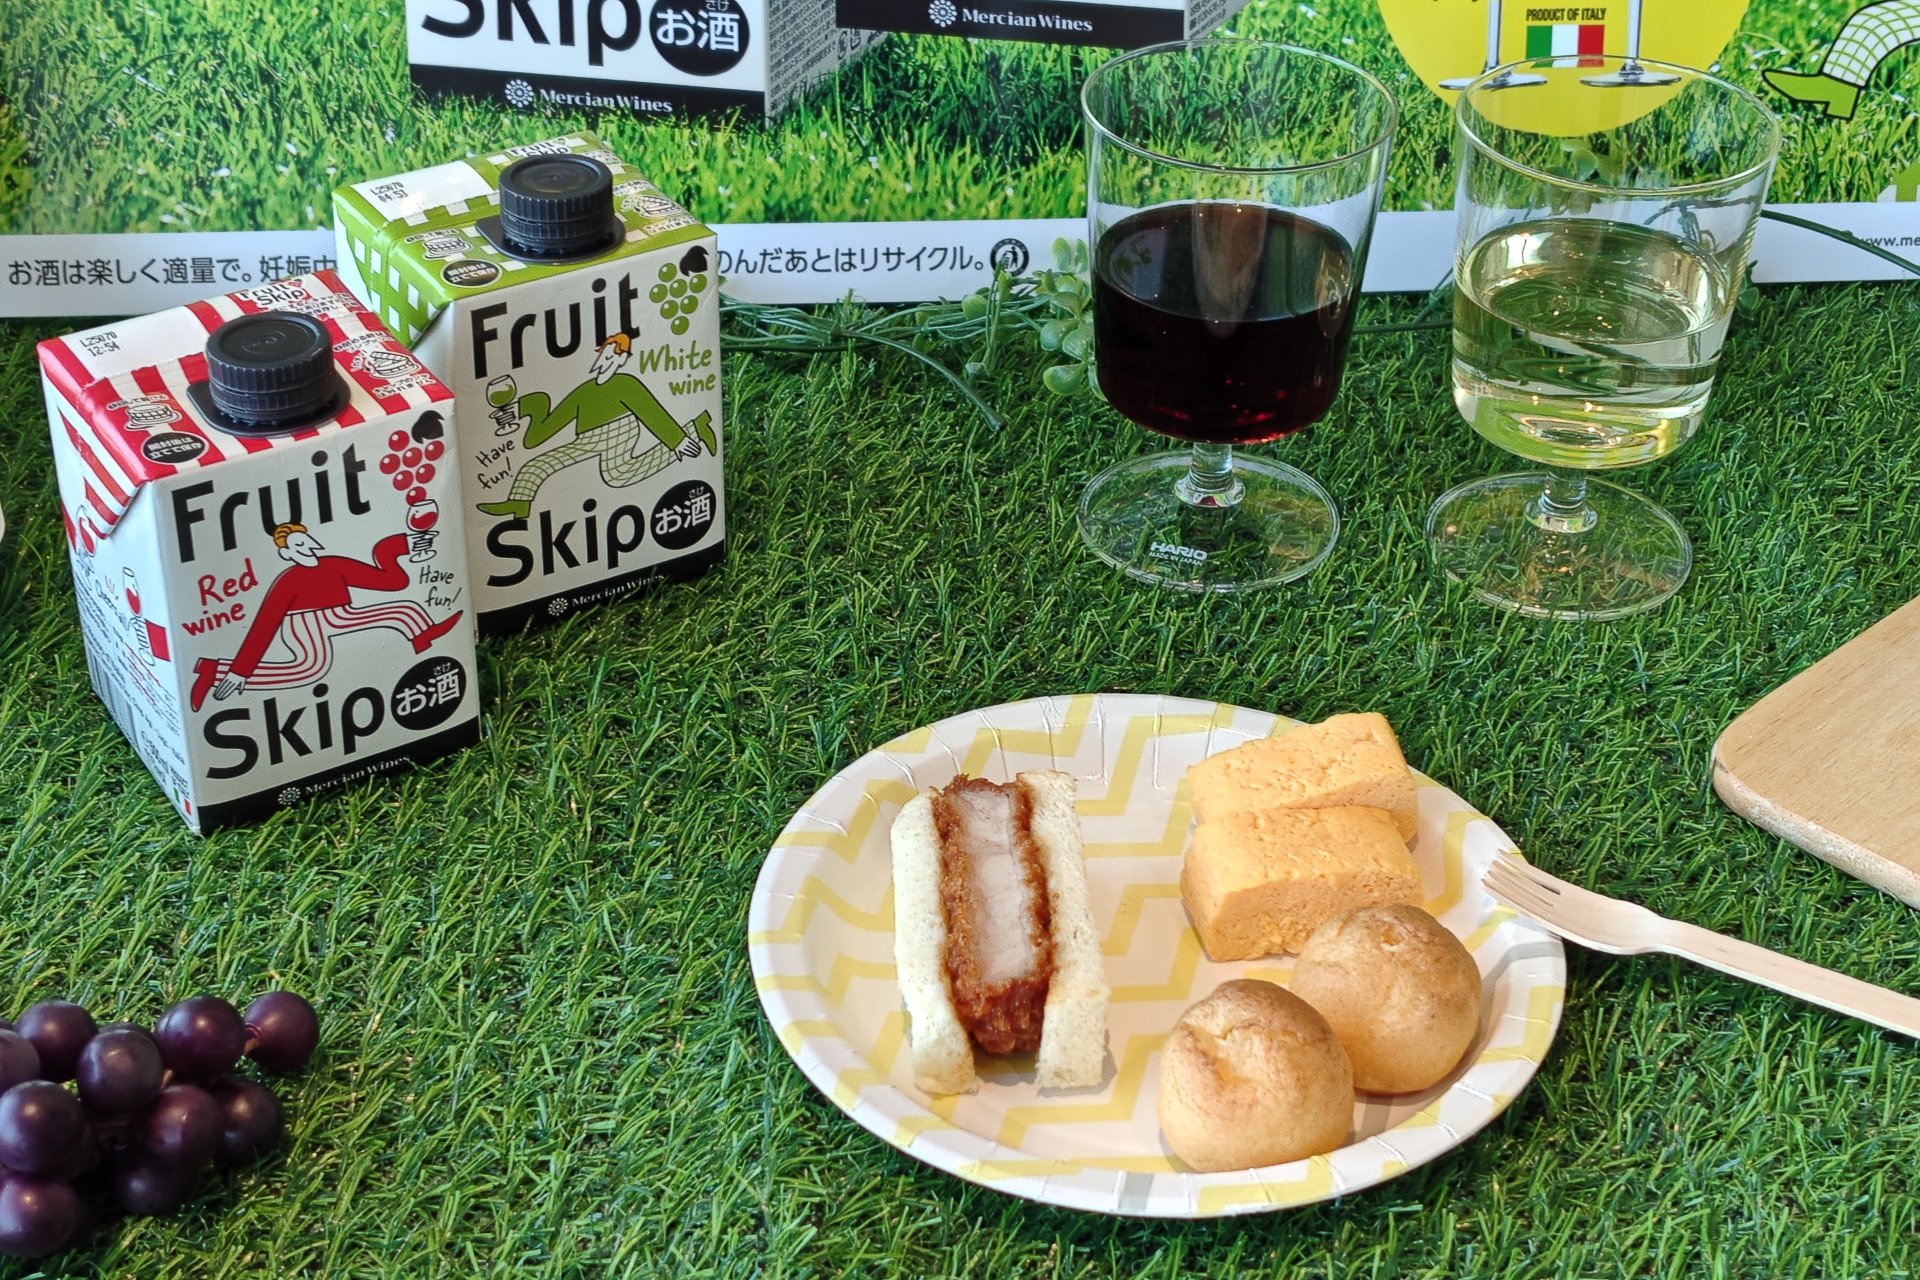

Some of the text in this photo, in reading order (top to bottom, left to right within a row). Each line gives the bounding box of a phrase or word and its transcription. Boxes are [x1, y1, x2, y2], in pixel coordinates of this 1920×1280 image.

[656, 9, 740, 53] お酒
[1526, 7, 1608, 22] PRODUCT OF ITALY
[717, 244, 985, 275] のんだあとはリサイクル。
[257, 288, 304, 306] Skip
[470, 272, 641, 380] Fruit
[87, 341, 121, 357] 12:54
[638, 340, 713, 375] White
[668, 372, 717, 396] wine
[475, 438, 516, 469] Have
[477, 456, 514, 490] fun!
[171, 442, 371, 564] Fruit
[655, 492, 712, 536] お酒
[486, 498, 646, 588] Skip
[197, 557, 260, 606] Red
[418, 565, 455, 586] Have
[425, 586, 463, 610] fun!
[182, 602, 247, 637] wine
[396, 668, 461, 717] お酒
[203, 683, 385, 780] Skip
